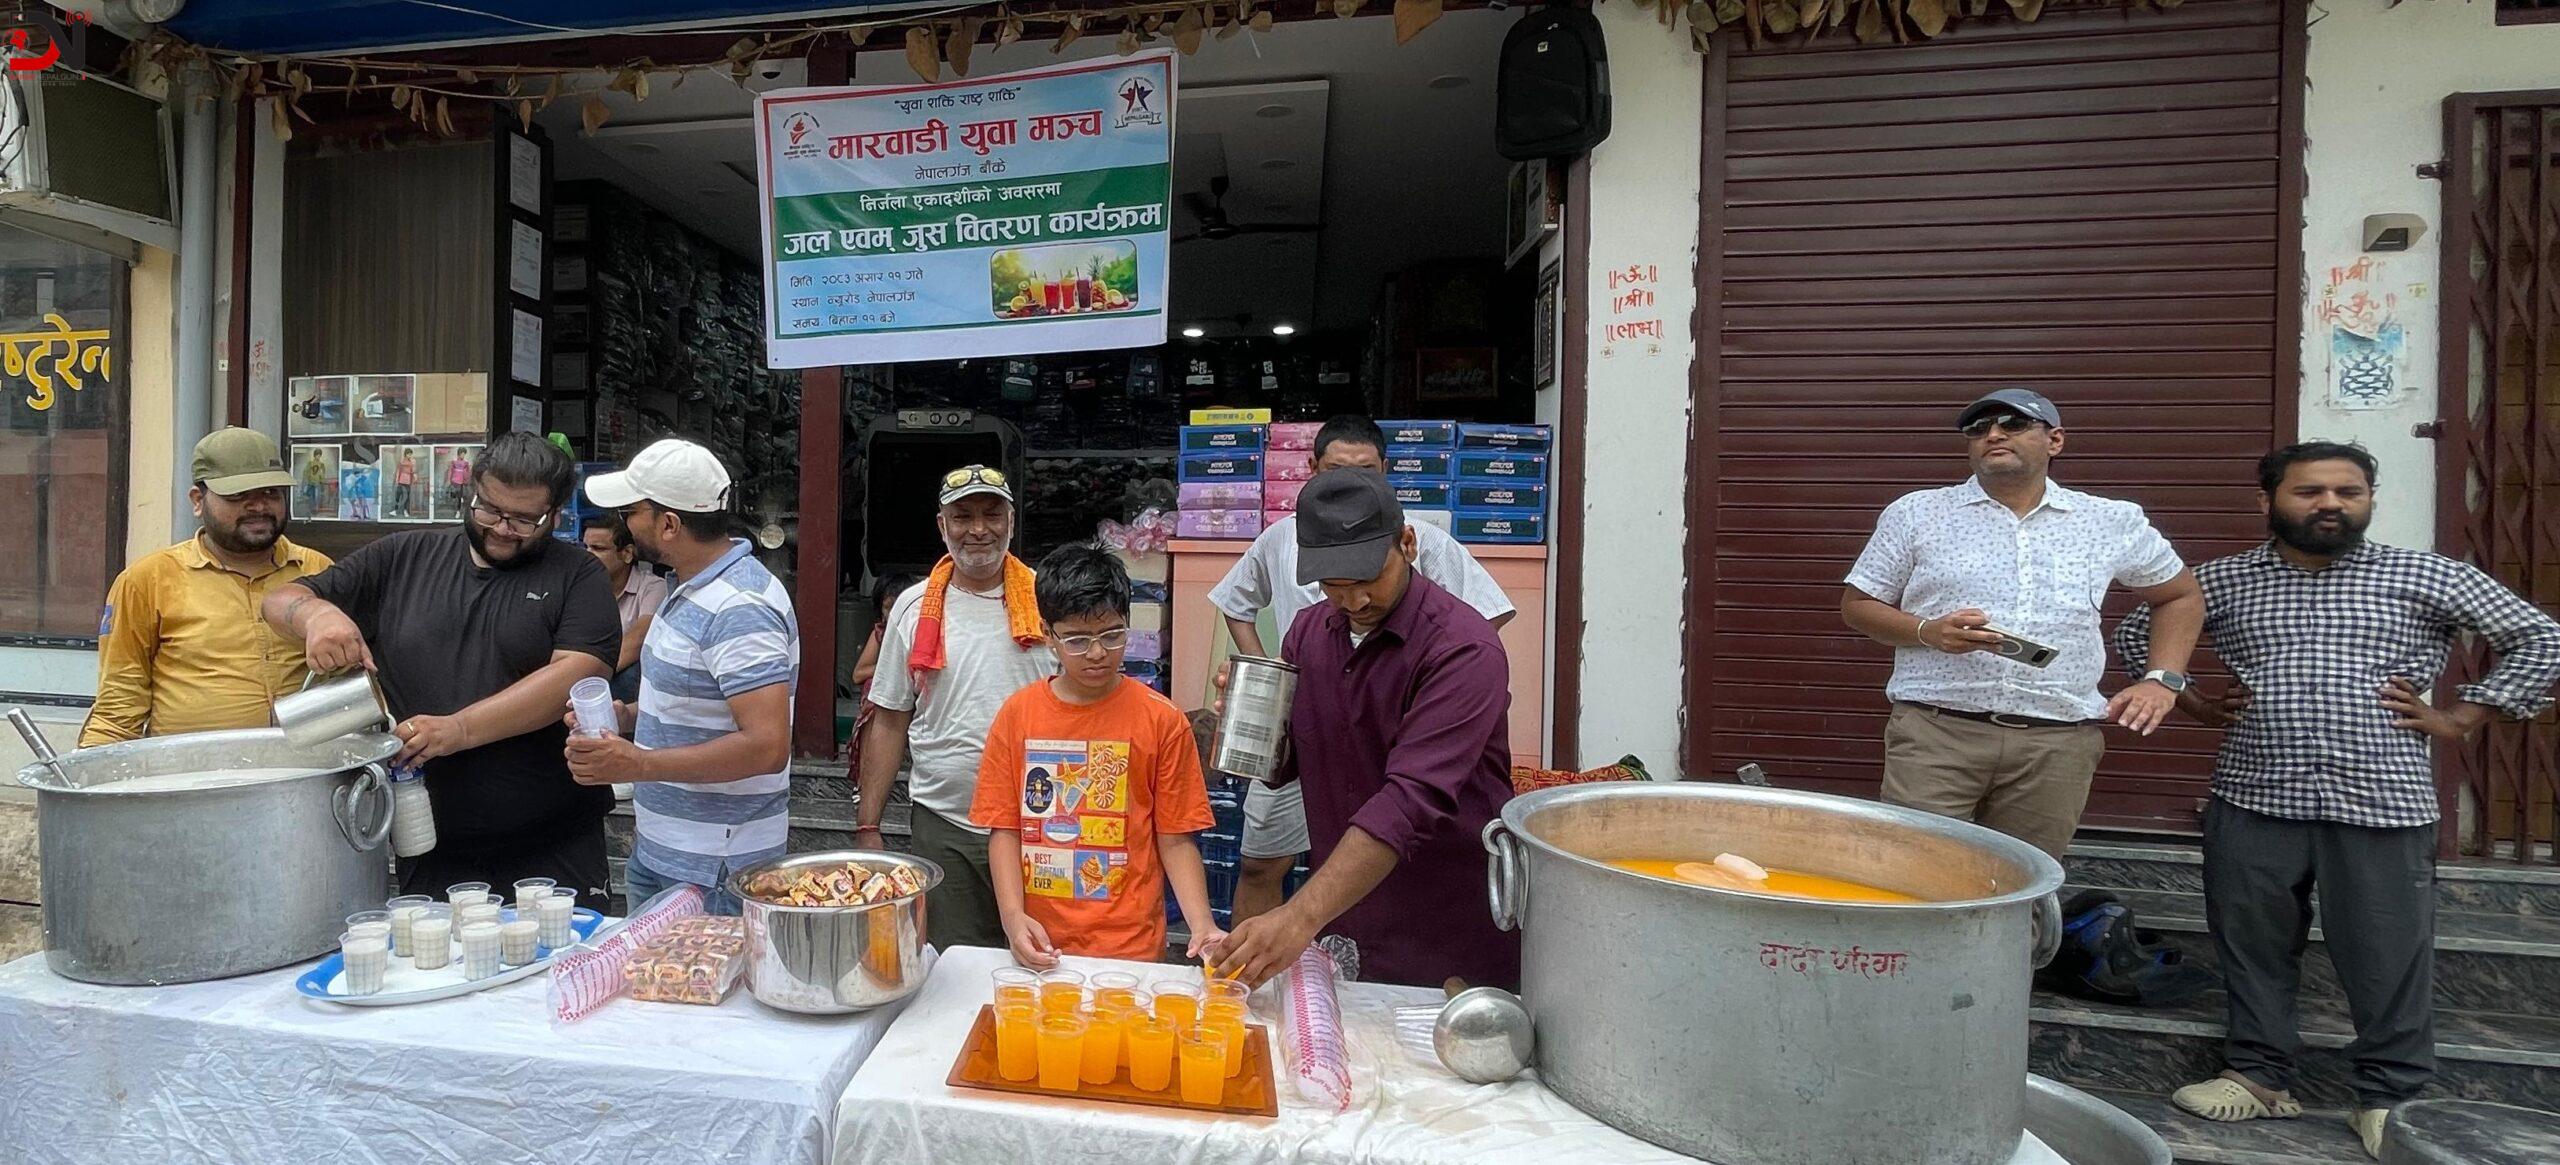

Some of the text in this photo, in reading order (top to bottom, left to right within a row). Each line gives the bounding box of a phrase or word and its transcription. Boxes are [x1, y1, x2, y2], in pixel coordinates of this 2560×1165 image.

[927, 94, 955, 108] शक्ति
[828, 118, 949, 160] मारवाडी
[959, 119, 1018, 156] युवा
[1028, 109, 1104, 142] मञ्च
[860, 182, 1063, 212] निर्जला एकादशीको अवसरमा
[783, 202, 1163, 255] जल एवम् जुस वितरण कार्यक्रम
